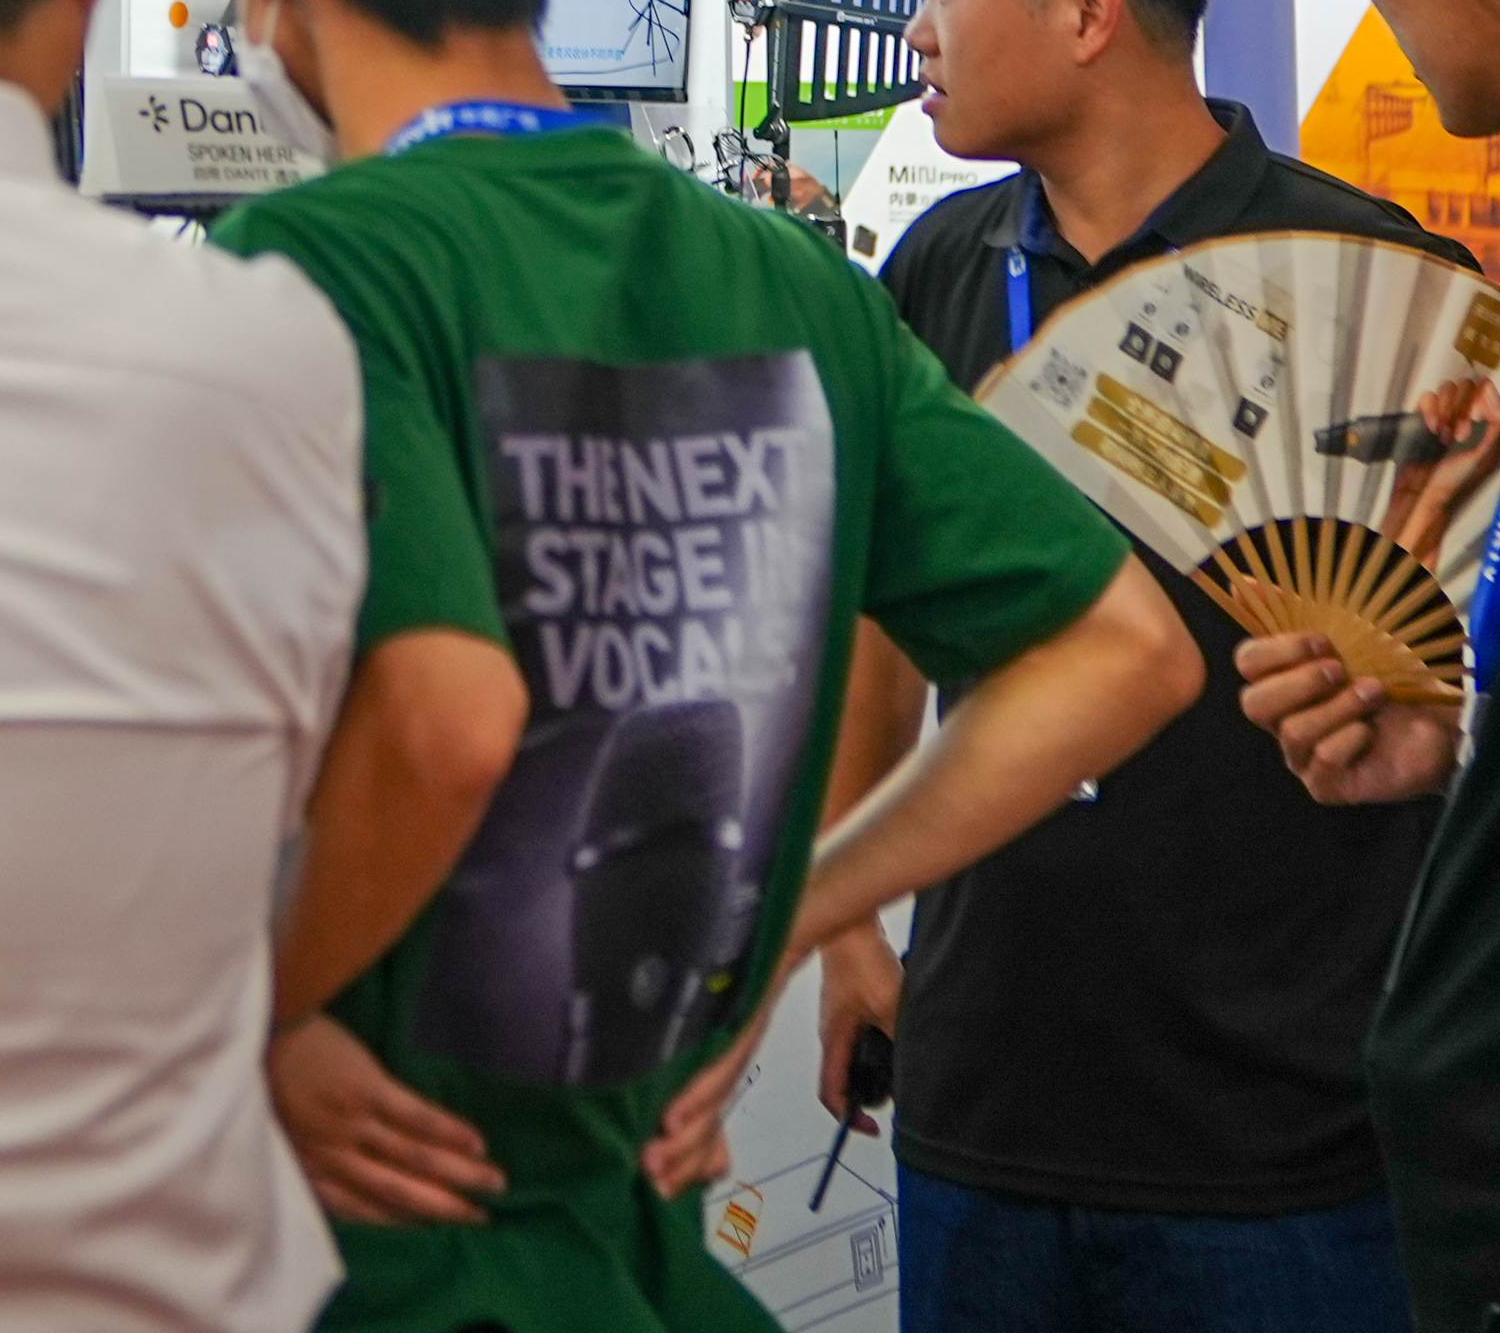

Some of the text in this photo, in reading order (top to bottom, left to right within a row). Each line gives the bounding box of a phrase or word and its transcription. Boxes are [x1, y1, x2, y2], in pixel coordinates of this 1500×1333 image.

[179, 98, 266, 135] Dan
[187, 141, 252, 163] SPOKEN
[618, 429, 807, 525] NEXT
[524, 527, 733, 618] STAGE
